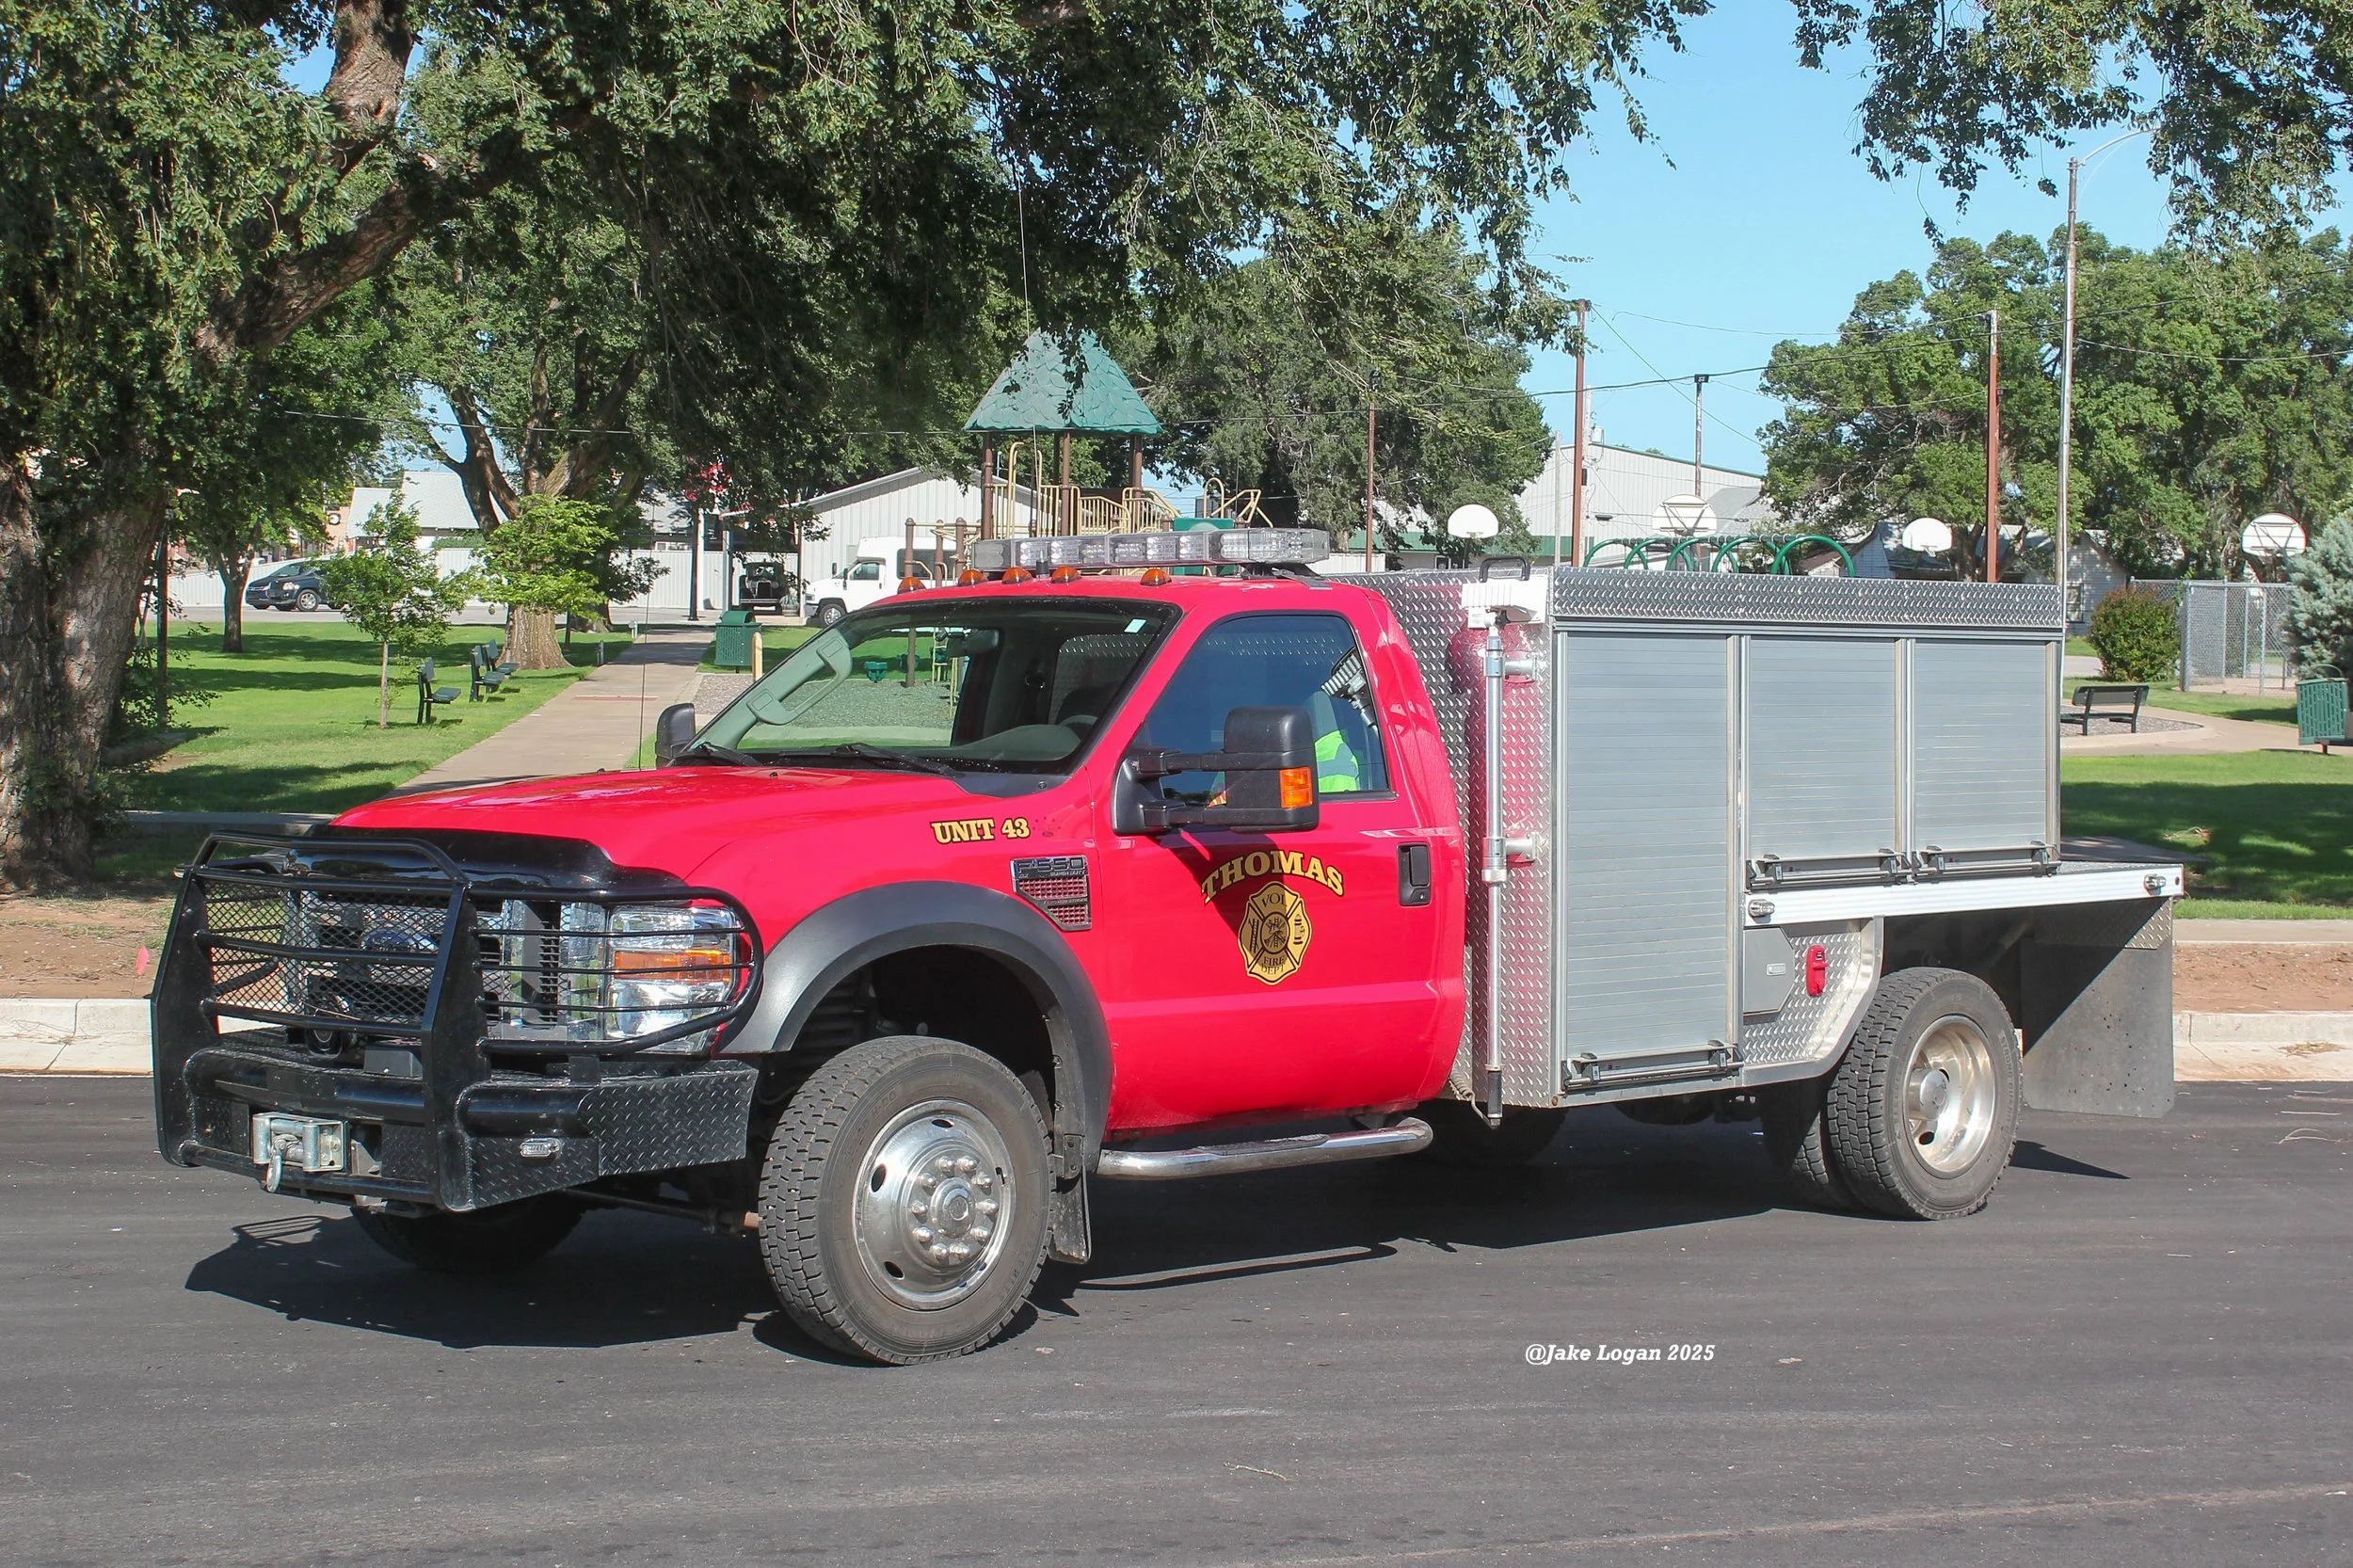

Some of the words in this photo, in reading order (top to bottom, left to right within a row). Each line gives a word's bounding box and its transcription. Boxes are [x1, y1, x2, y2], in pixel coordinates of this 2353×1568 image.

[930, 818, 995, 844] UNIT
[1000, 817, 1031, 839] 43
[1201, 850, 1344, 904] THOMAS
[1261, 965, 1284, 976] DEPT
[1263, 956, 1285, 967] FIRE
